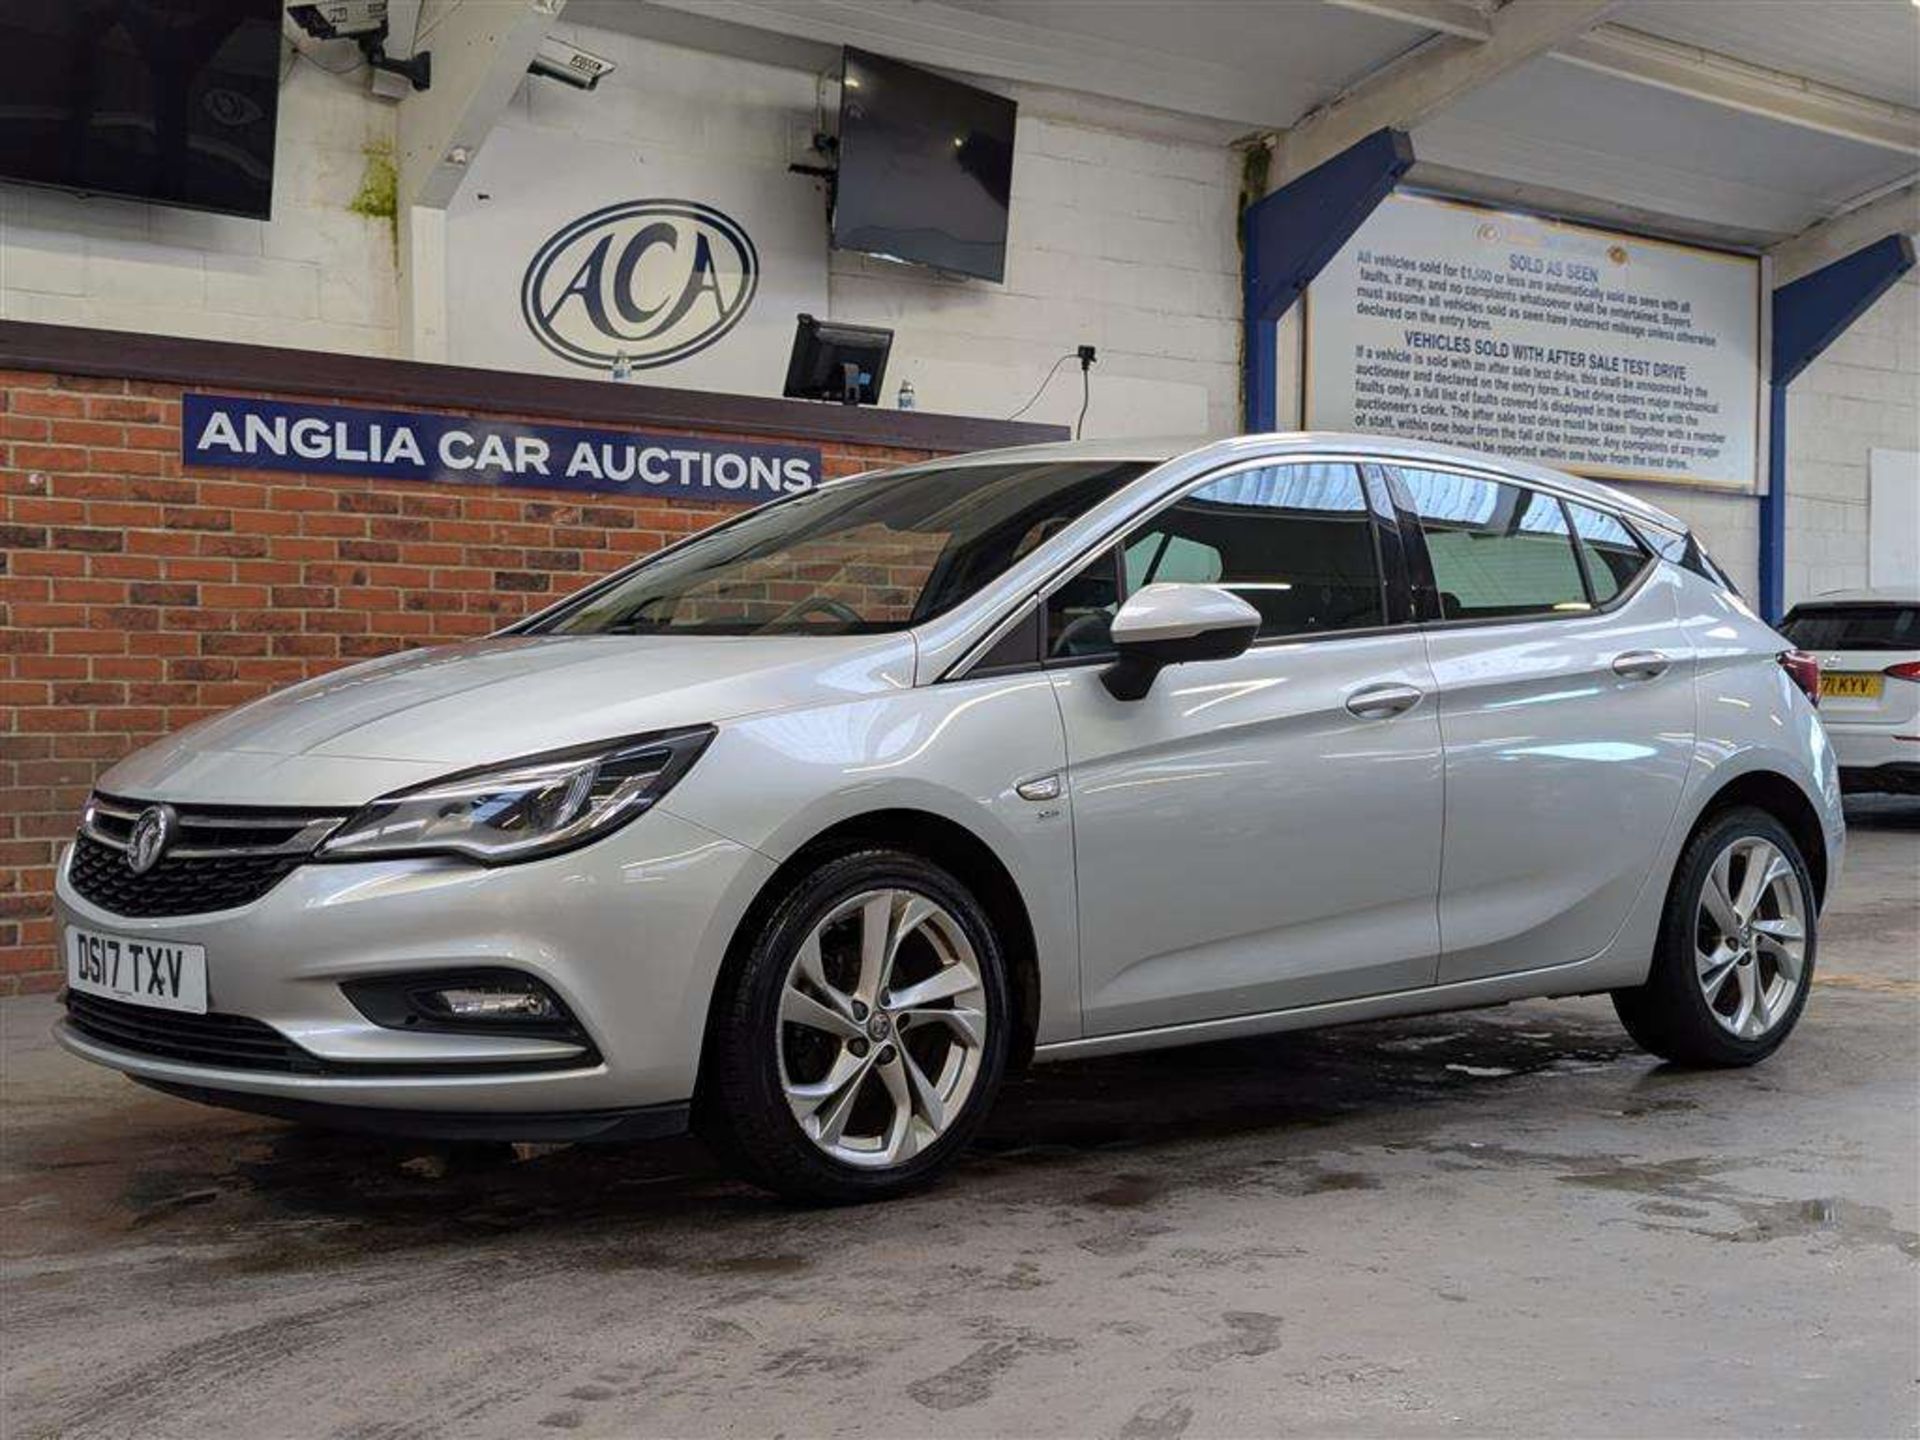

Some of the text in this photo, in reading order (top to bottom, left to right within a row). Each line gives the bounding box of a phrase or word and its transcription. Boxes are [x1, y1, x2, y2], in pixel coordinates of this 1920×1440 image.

[545, 222, 728, 341] ACA
[1357, 249, 1370, 264] All
[1374, 252, 1415, 271] vehicles
[1419, 259, 1440, 275] sold
[1443, 263, 1457, 278] for
[1494, 274, 1504, 285] or
[1507, 273, 1524, 288] less
[1528, 279, 1542, 290] are
[1545, 279, 1603, 303] automatically
[1606, 288, 1624, 303] sold
[1627, 294, 1637, 305] as
[1639, 296, 1659, 308] seen
[1661, 297, 1678, 311] with
[1681, 300, 1690, 313] all
[1395, 272, 1401, 286] if
[1429, 277, 1446, 292] and
[1449, 283, 1461, 295] no
[1465, 283, 1515, 306] complaints
[1520, 291, 1570, 310] whatsoever
[1574, 299, 1593, 314] shall
[1597, 302, 1606, 315] be
[1509, 253, 1597, 285] SOLD AS SEEN
[1356, 284, 1716, 346] must assume all vehicles sold as seen have incorrect mileage unless otherwise
[1356, 300, 1401, 319] declared
[1404, 309, 1416, 321] on
[1420, 309, 1436, 324] the
[1438, 312, 1464, 331] entry
[1355, 344, 1363, 358] If
[1366, 348, 1372, 359] a
[1374, 346, 1411, 363] vehicle
[1414, 351, 1423, 365] is
[1426, 352, 1447, 368] sold
[1450, 355, 1472, 370] with
[1474, 361, 1485, 372] an
[1490, 360, 1509, 375] after
[1512, 363, 1530, 377] sale
[1533, 366, 1551, 380] test
[1579, 371, 1598, 385] this
[1600, 373, 1620, 388] shall
[1623, 376, 1633, 389] be
[1636, 378, 1680, 395] announced
[1683, 383, 1692, 400] by
[1694, 385, 1707, 398] the
[1404, 330, 1686, 381] VEHICLES SOLD WITH AFTER SALE TEST DRIVE
[1355, 361, 1410, 380] auctioneer
[1414, 367, 1431, 382] and
[1434, 370, 1477, 387] declared
[1480, 378, 1492, 389] on
[1494, 377, 1509, 391] the
[1511, 379, 1534, 397] entry
[1564, 385, 1570, 397] A
[1572, 386, 1589, 400] test
[1591, 388, 1613, 402] drive
[1615, 393, 1644, 406] covers
[1646, 397, 1670, 412] major
[1673, 397, 1718, 414] mechanical
[1355, 378, 1384, 394] faults
[1414, 387, 1421, 397] a
[1423, 385, 1439, 399] full
[1441, 387, 1457, 401] list
[1459, 389, 1469, 402] of
[1472, 390, 1498, 405] faults
[1501, 393, 1537, 409] covered
[1540, 397, 1548, 410] is
[1550, 399, 1593, 419] displayed
[1597, 404, 1604, 416] in
[1607, 405, 1620, 418] the
[1623, 406, 1646, 421] office
[1648, 409, 1664, 422] and
[1667, 411, 1683, 424] with
[1685, 413, 1698, 426] the
[1354, 412, 1365, 426] of
[1398, 416, 1429, 431] within
[1430, 422, 1448, 433] one
[1451, 421, 1473, 435] hour
[1477, 423, 1499, 438] from
[1502, 426, 1516, 439] the
[1518, 427, 1532, 441] fall
[1535, 429, 1544, 442] of
[1546, 430, 1560, 443] the
[1603, 435, 1619, 452] Any
[1622, 437, 1668, 457] complaints
[1670, 442, 1679, 454] of
[1681, 445, 1694, 459] any
[1696, 447, 1719, 461] major
[1355, 395, 1417, 414] auctioneer's
[1451, 404, 1469, 419] The
[1472, 407, 1494, 421] after
[1497, 409, 1515, 423] sale
[1518, 412, 1536, 425] test
[1538, 413, 1560, 428] drive
[1563, 417, 1585, 430] must
[1587, 418, 1598, 431] be
[1630, 423, 1665, 441] together
[1668, 426, 1684, 439] with
[1686, 431, 1691, 440] a
[1694, 429, 1725, 443] member
[197, 411, 812, 492] ANGLIA CAR AUCTIONS
[1483, 440, 1494, 453] be
[1497, 441, 1537, 461] reported
[1539, 445, 1565, 459] within
[1569, 450, 1584, 461] one
[1587, 449, 1606, 463] hour
[1609, 451, 1629, 464] from
[1633, 453, 1646, 466] the
[1648, 455, 1663, 467] test
[77, 933, 182, 998] DS17 TXV
